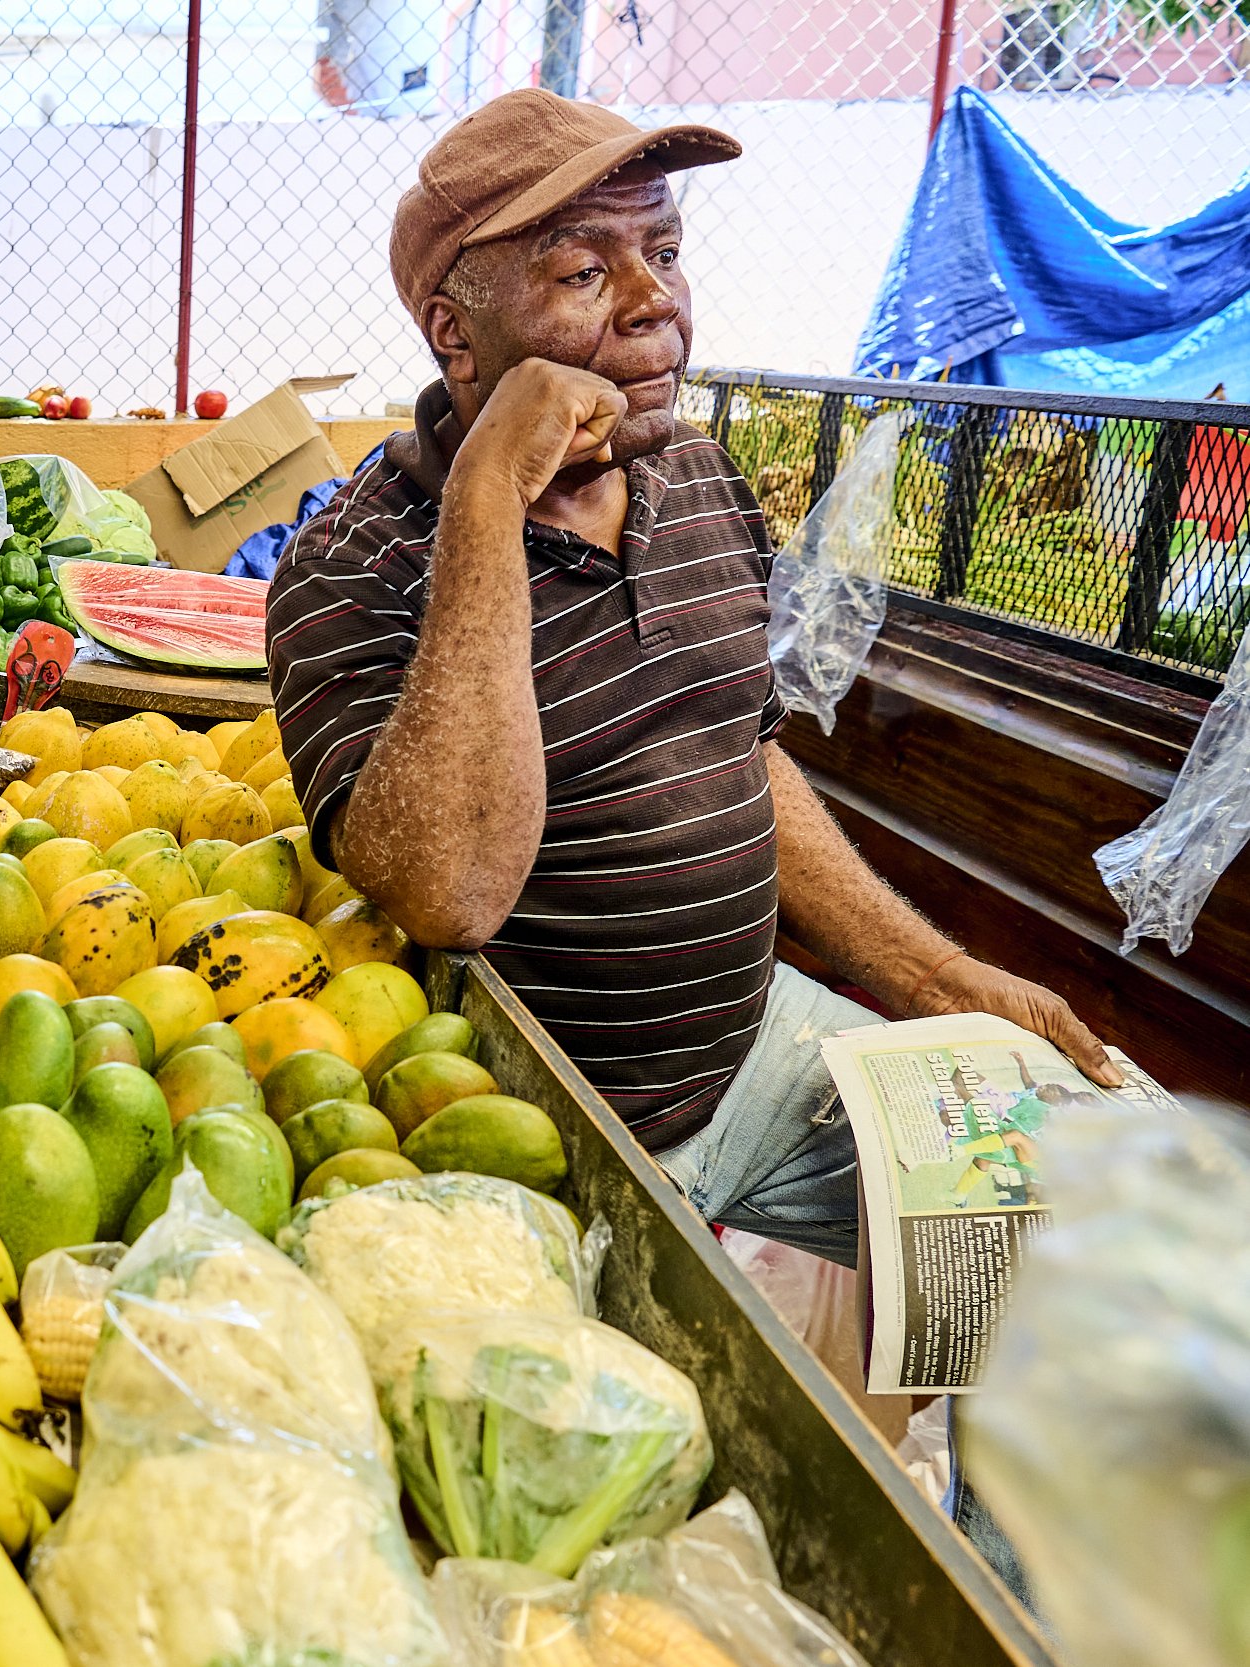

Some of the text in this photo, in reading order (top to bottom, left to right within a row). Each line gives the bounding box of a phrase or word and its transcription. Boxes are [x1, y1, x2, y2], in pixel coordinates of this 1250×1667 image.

[926, 1052, 969, 1138] standing
[952, 1052, 999, 1134] Four left
[928, 1220, 936, 1246] Courtney
[983, 1228, 992, 1250] (MBU)
[922, 1236, 930, 1259] minutes
[967, 1240, 977, 1271] Sunday's
[976, 1237, 984, 1251] over
[980, 1275, 988, 1301] months
[987, 1252, 995, 1280] ensured
[962, 1278, 970, 1299] staying
[970, 1273, 979, 1292] (April
[989, 1282, 997, 1298] their
[910, 1340, 918, 1358] Cont'd
